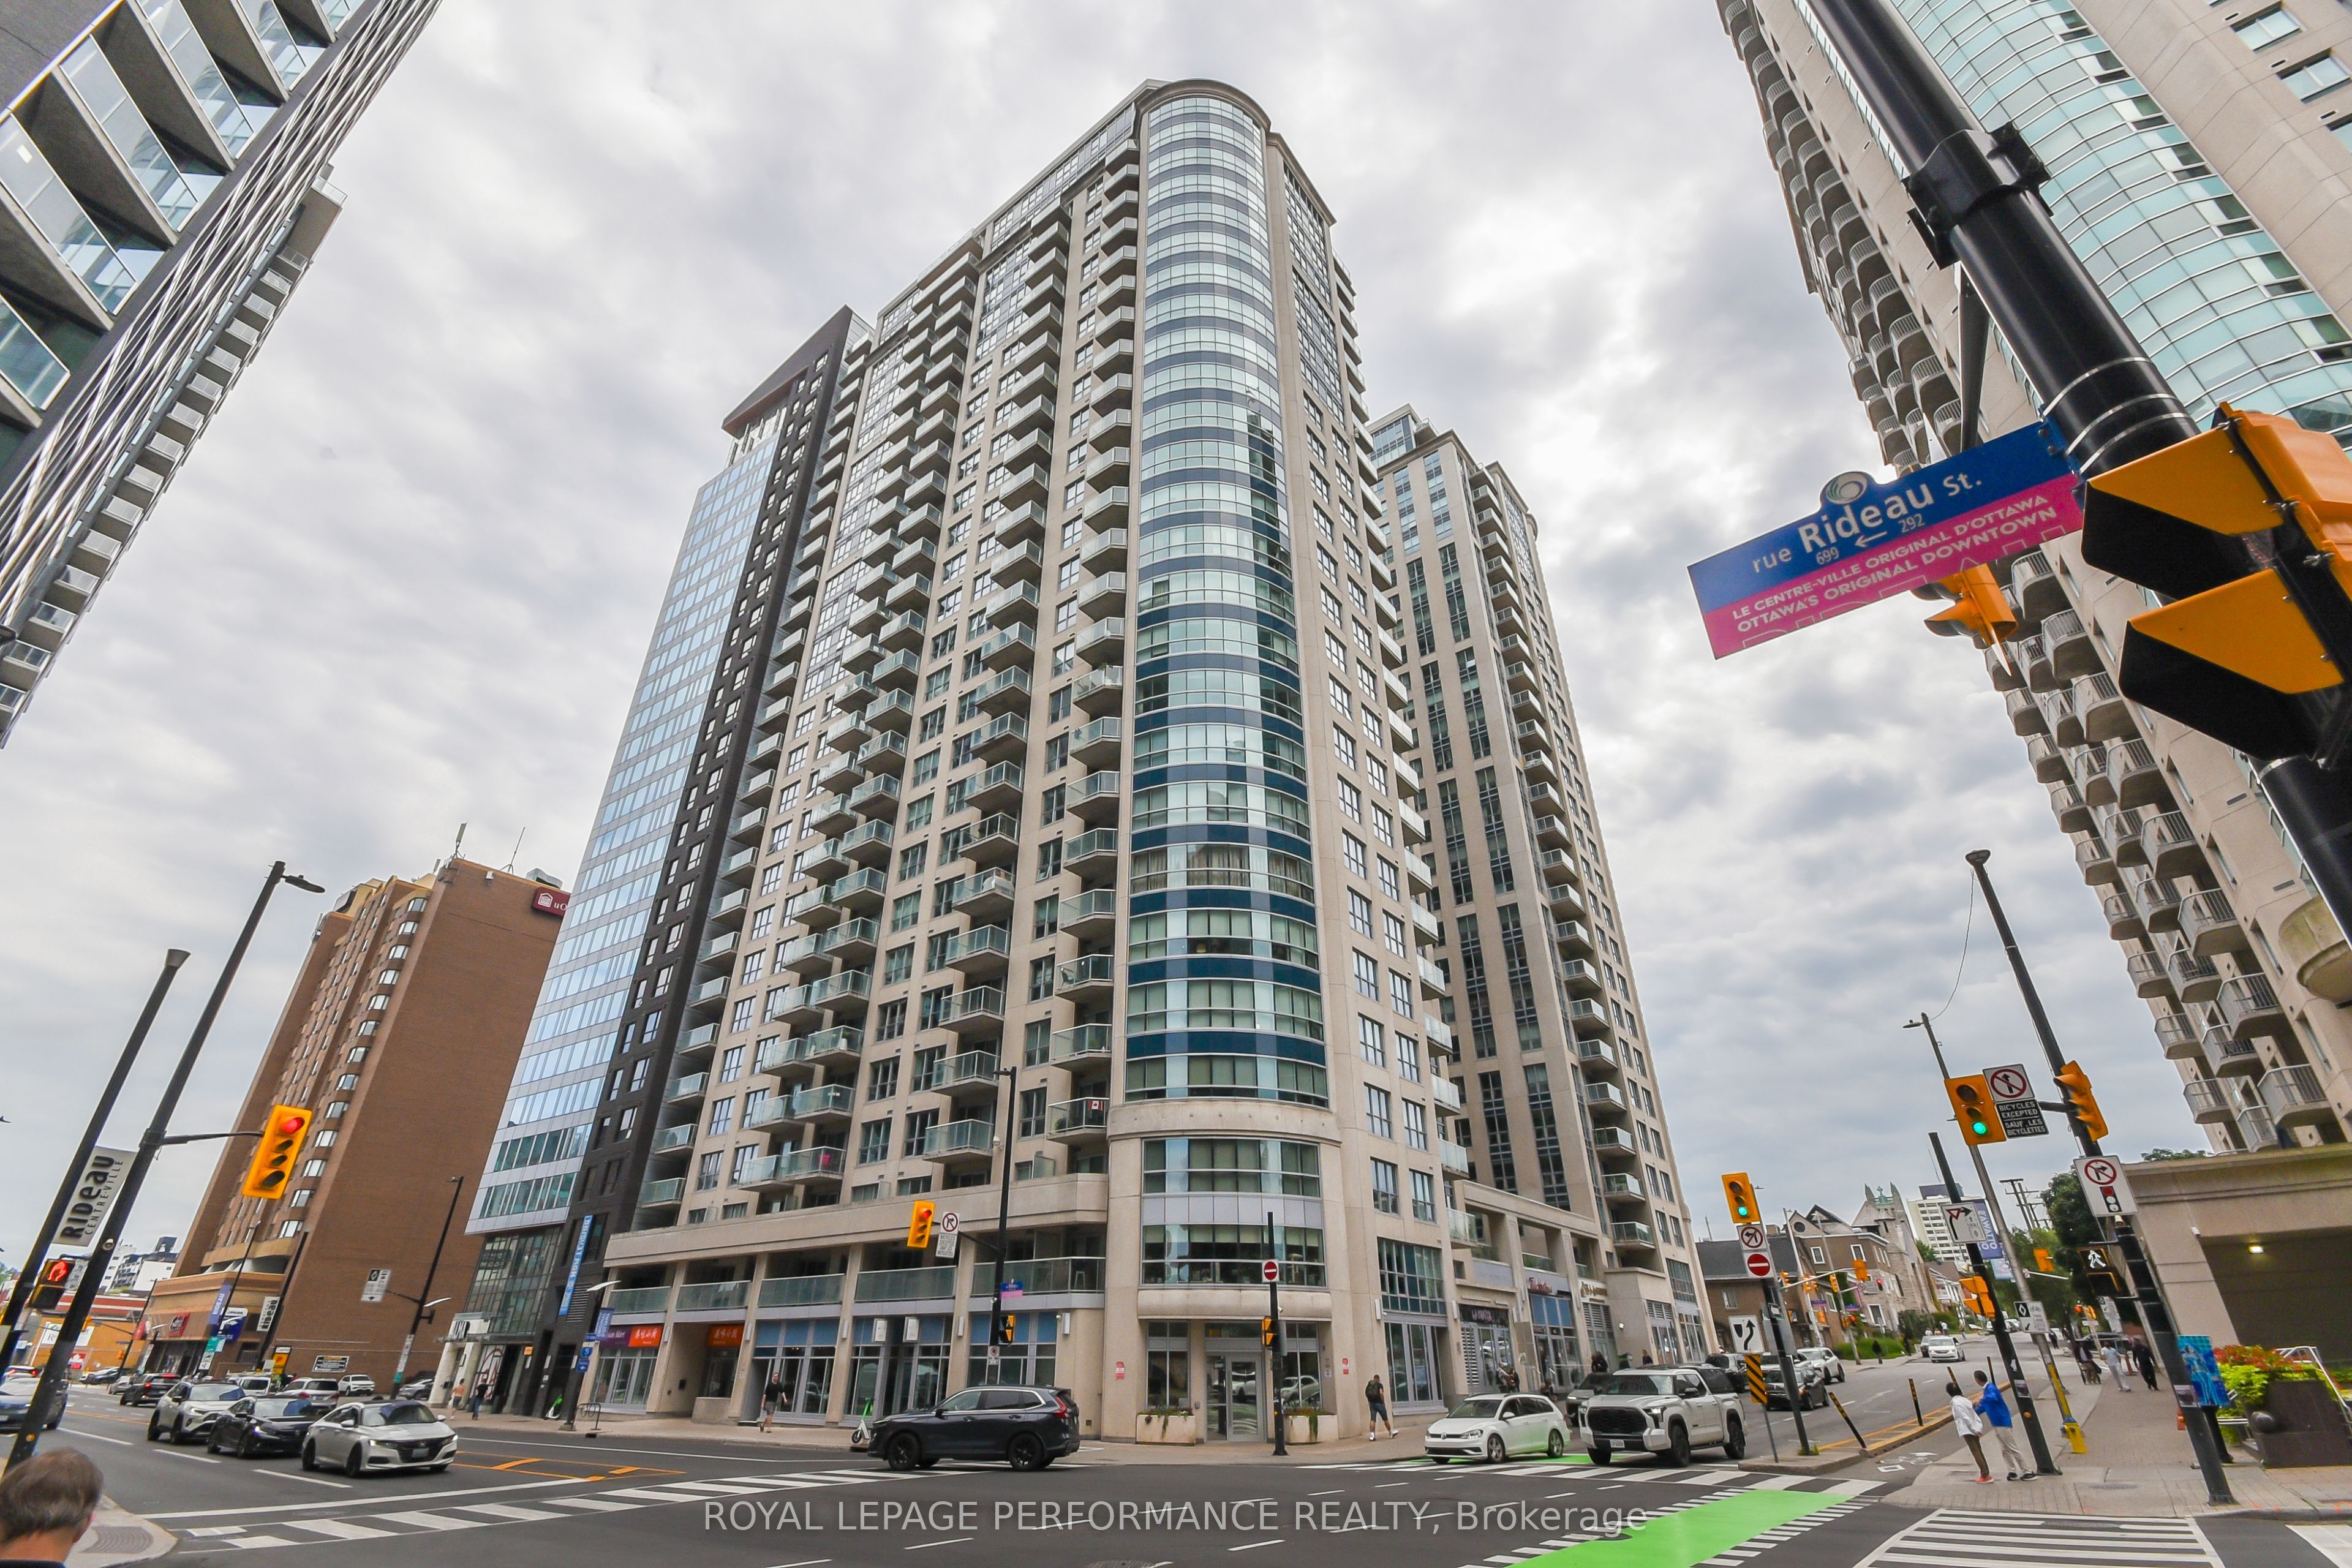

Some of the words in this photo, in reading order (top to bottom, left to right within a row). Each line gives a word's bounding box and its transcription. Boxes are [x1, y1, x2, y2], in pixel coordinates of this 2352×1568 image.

[1752, 548, 1792, 573] rue
[1798, 483, 1934, 553] Rideau
[1942, 472, 1983, 497] St.
[1898, 513, 1926, 533] 292
[1733, 605, 1749, 620] LE
[1754, 564, 1862, 611] CENTRE-VILLE
[1865, 531, 1952, 568] ORIGINAL
[1954, 495, 2049, 537] D'OTTAWA
[1815, 546, 1839, 565] 699
[1737, 595, 1820, 632] OTTAWA'S
[1824, 559, 1918, 600] ORIGINAL
[1921, 507, 2057, 565] DOWNTOWN
[1998, 1101, 2035, 1112] BICYCLES
[2001, 1109, 2038, 1118] EXCEPTED
[2007, 1126, 2046, 1136] BICYCLETTES
[85, 1161, 124, 1235] CENTRE-VILLE
